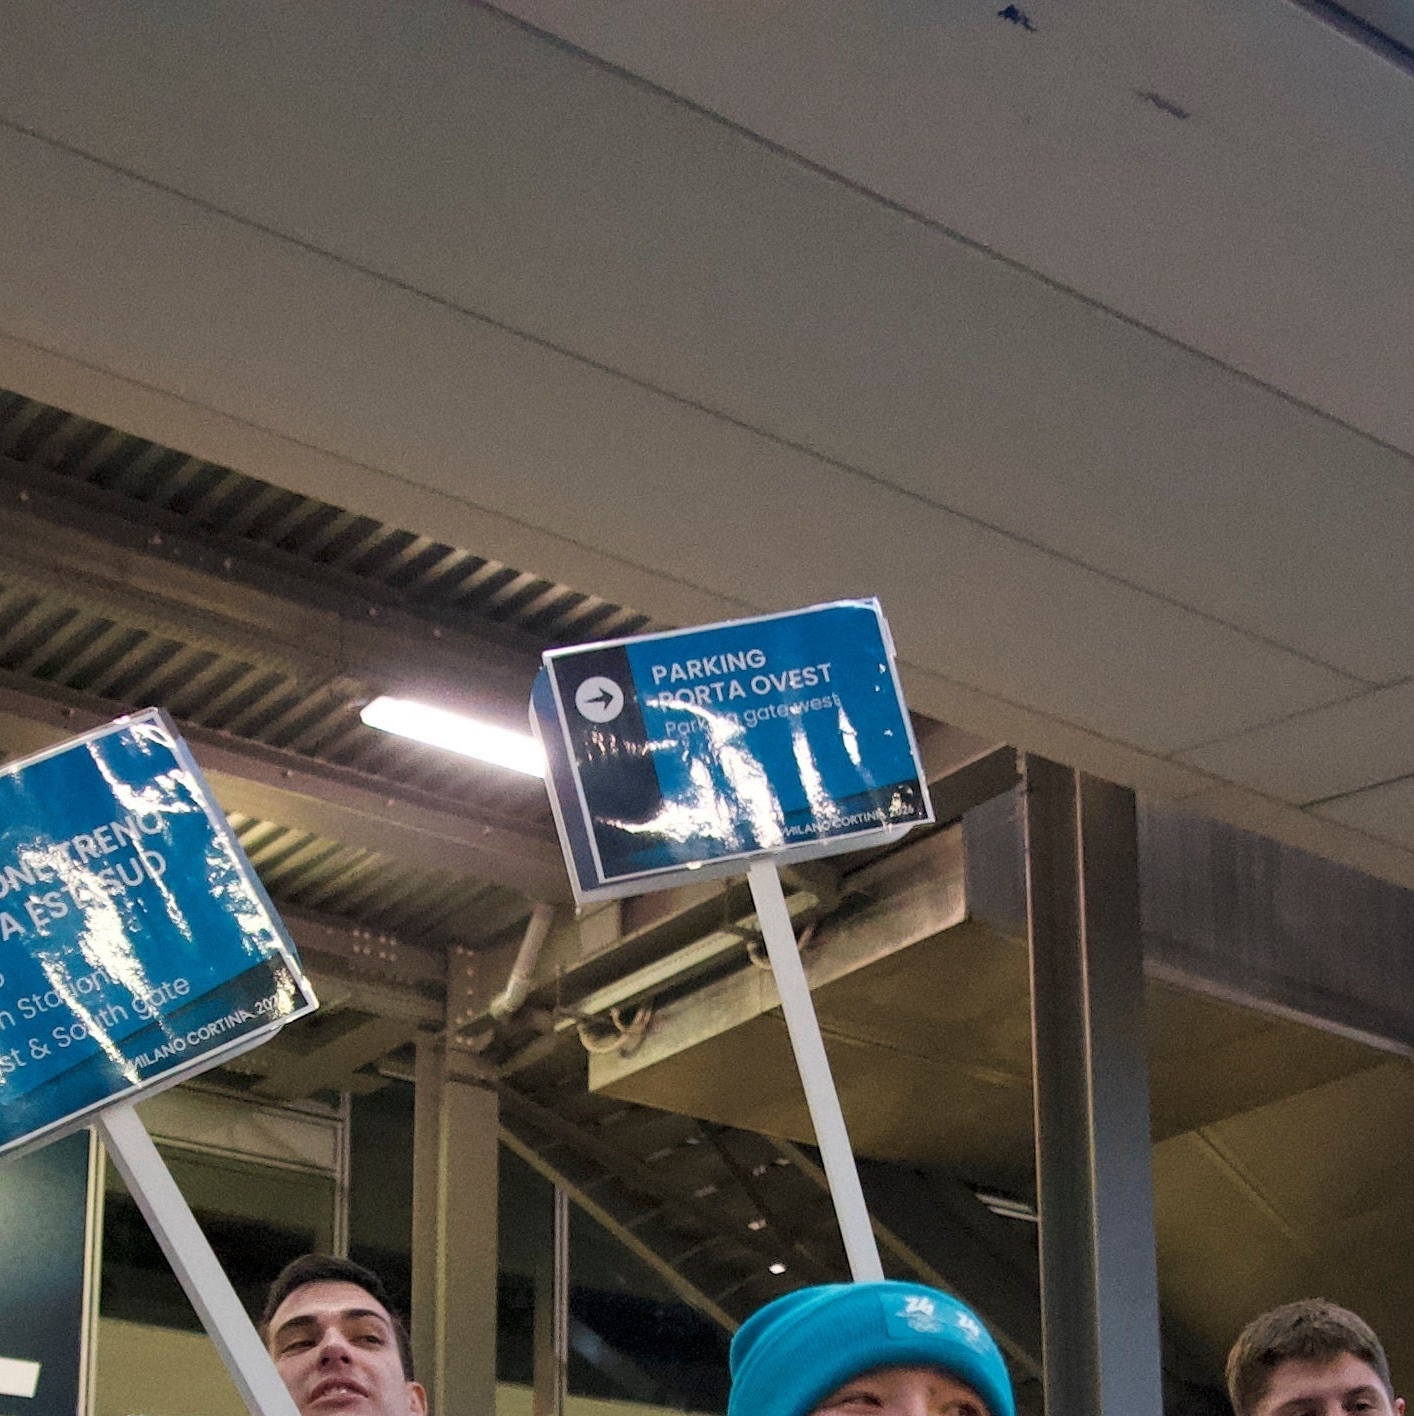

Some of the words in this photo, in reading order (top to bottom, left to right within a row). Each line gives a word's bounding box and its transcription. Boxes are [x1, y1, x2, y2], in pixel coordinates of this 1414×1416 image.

[651, 648, 767, 686] PARKING
[658, 679, 747, 712] PORTA
[750, 662, 832, 696] OVEST
[743, 702, 789, 728] gate
[789, 691, 841, 714] west
[48, 811, 164, 868] TRENO
[98, 850, 167, 897] SUD
[17, 968, 110, 1020] Staion
[29, 1037, 52, 1060] &
[131, 977, 191, 1020] gate
[186, 1009, 257, 1046] CORTINA
[254, 993, 279, 1015] 202
